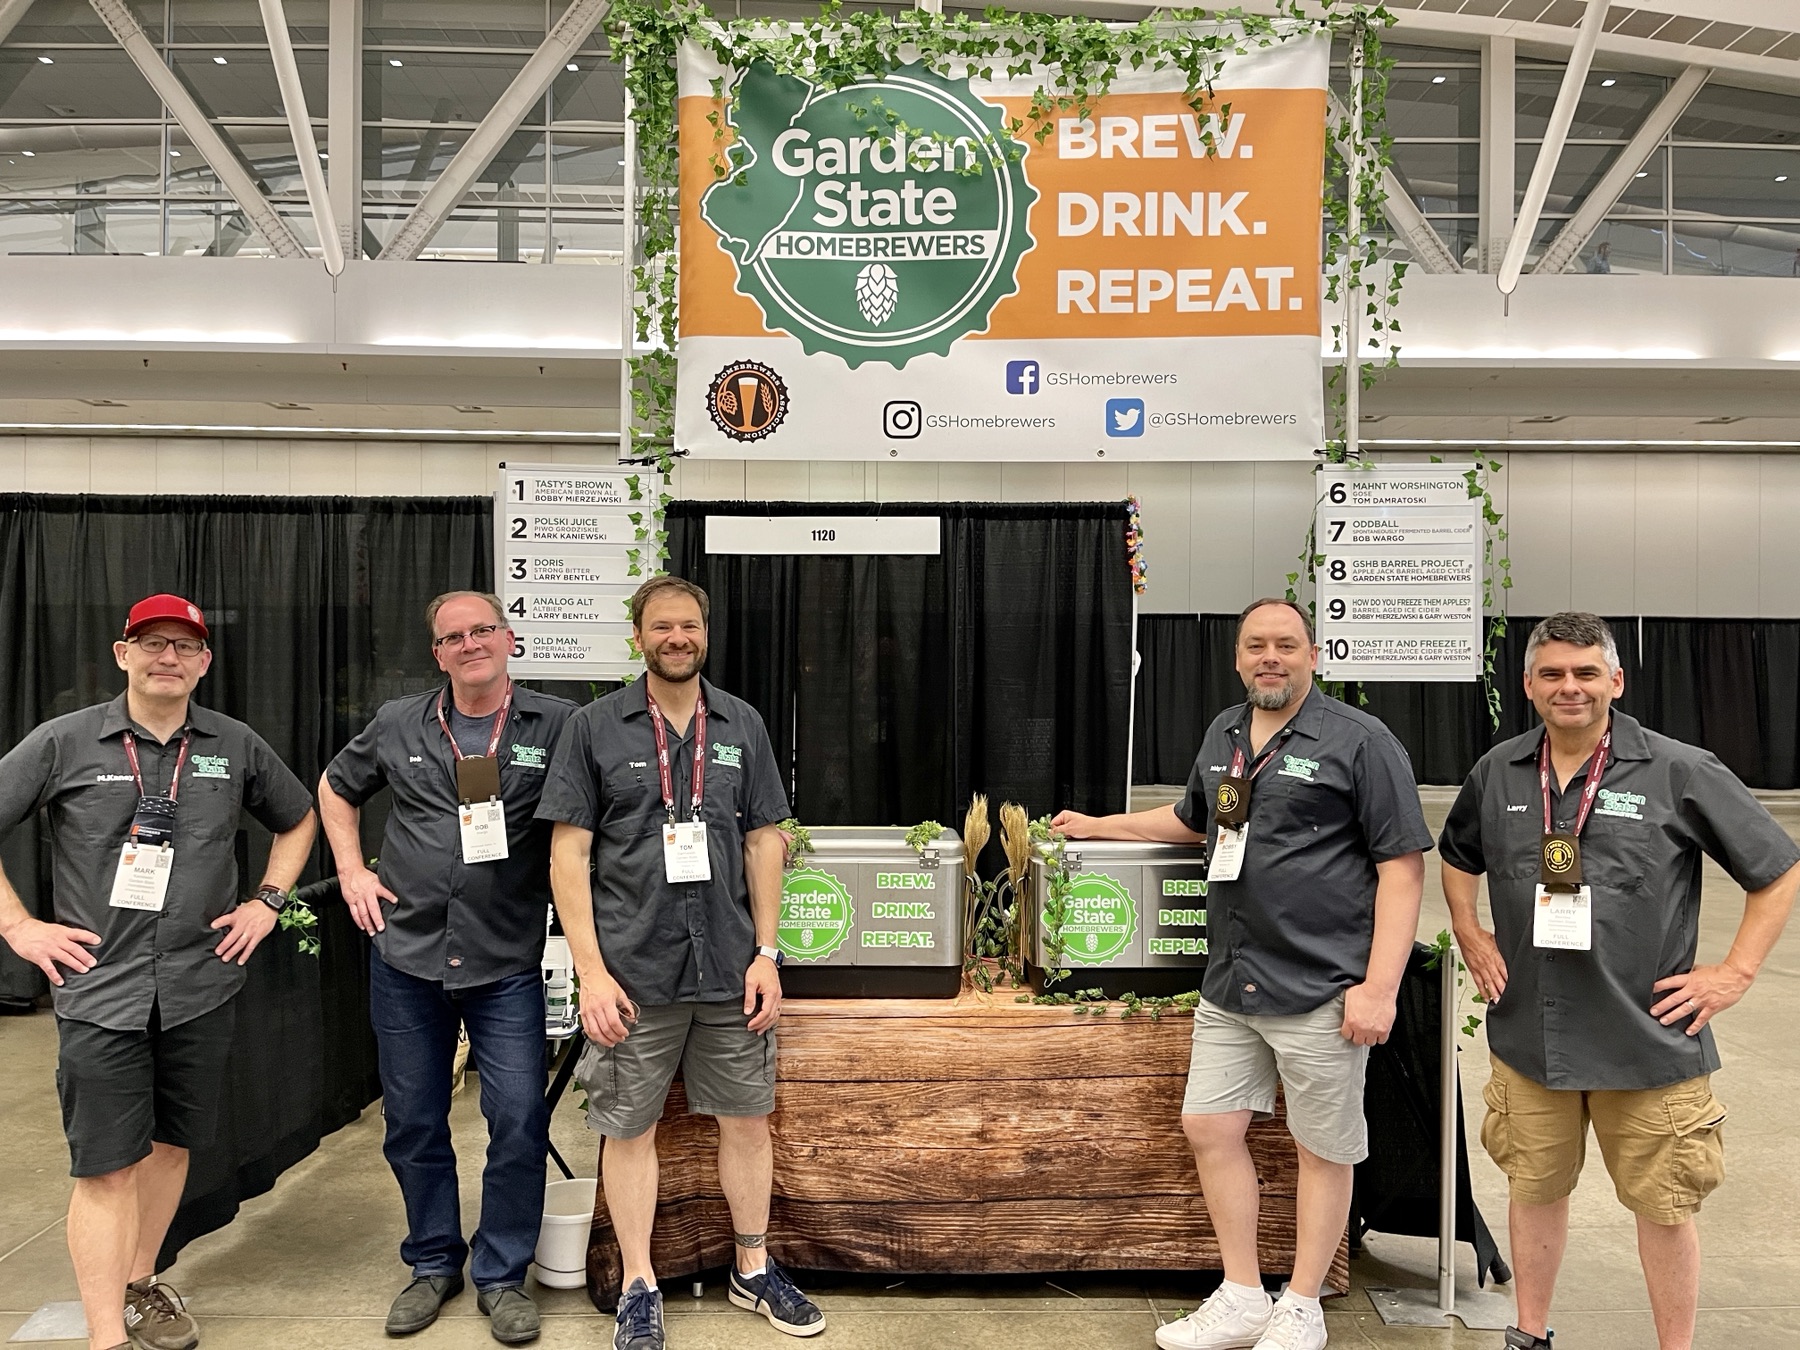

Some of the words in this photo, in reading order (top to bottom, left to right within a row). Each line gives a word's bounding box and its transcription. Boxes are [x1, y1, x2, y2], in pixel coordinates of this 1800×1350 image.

[1058, 113, 1254, 160] BREW.
[772, 125, 977, 177] Garden
[812, 179, 957, 228] State
[1058, 192, 1267, 236] DRINK.
[776, 234, 986, 258] HOMEBREWERS
[1057, 266, 1302, 314] REPEAT.
[716, 363, 780, 386] HOMEBREWERS
[1046, 371, 1178, 386] GSHomebrewers
[710, 392, 738, 436] AMERICAN
[743, 394, 786, 439] ASSOCIATION
[926, 414, 1056, 429] GSHomebrewers
[1148, 412, 1297, 428] @GSHomebrewers
[515, 480, 524, 501] 1
[535, 480, 573, 489] TASTY'S
[575, 481, 613, 489] BROWN
[1353, 482, 1388, 490] MAHNT
[1329, 482, 1347, 504] 6
[511, 518, 527, 538] 2
[534, 518, 568, 526] POLSKI
[571, 518, 598, 526] JUICE
[1353, 520, 1399, 528] ODDBALL
[811, 530, 836, 542] 1120
[1330, 521, 1346, 542] 7
[511, 558, 527, 580] 3
[534, 559, 564, 567] DORIS
[1329, 560, 1347, 581] 8
[1353, 560, 1379, 568] GSHB
[564, 574, 600, 582] BENTLEY
[508, 597, 527, 618] 4
[533, 598, 574, 606] ANALOG
[576, 598, 594, 606] ALT
[1329, 598, 1346, 620] 9
[510, 637, 526, 658] 5
[533, 637, 554, 645] OLD
[556, 637, 578, 645] MAN
[553, 652, 585, 660] WARGO
[1326, 639, 1349, 660] 10
[1598, 788, 1646, 806] Garden
[1506, 804, 1528, 813] Larry
[1603, 800, 1638, 813] State
[468, 852, 502, 861] CONFERENCE
[134, 866, 156, 875] MARK
[877, 873, 935, 889] BREW.
[117, 900, 157, 908] CONFERENCE
[781, 889, 838, 904] Garden
[1062, 894, 1121, 909] Garden
[788, 904, 832, 920] State
[872, 902, 935, 919] DRINK.
[1073, 909, 1116, 924] State
[862, 931, 934, 948] REPEAT.
[1149, 938, 1208, 954] REPEA
